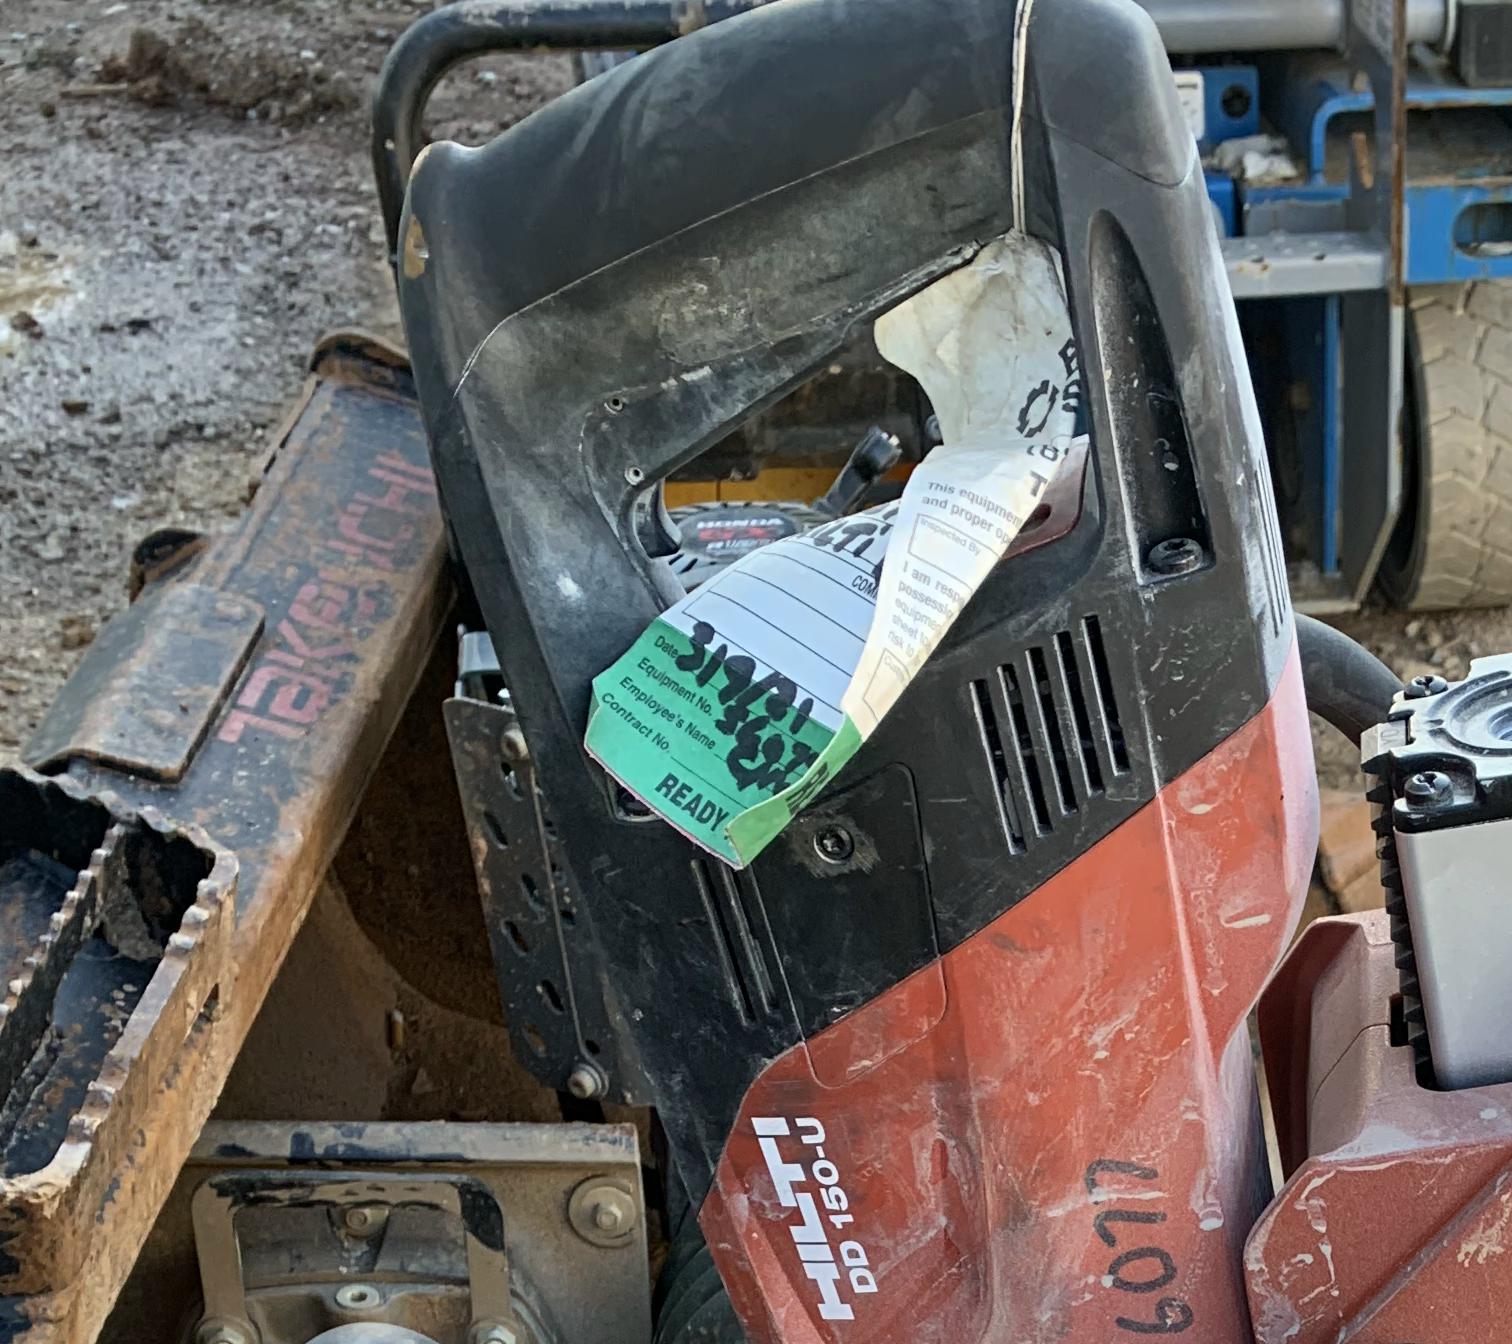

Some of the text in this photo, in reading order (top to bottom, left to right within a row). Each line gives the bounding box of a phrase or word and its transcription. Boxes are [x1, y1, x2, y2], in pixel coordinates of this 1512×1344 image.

[922, 496, 949, 509] and
[950, 503, 993, 532] proper
[928, 482, 956, 494] This
[911, 569, 932, 586] am
[654, 635, 679, 659] Date
[619, 675, 716, 750] Employee's Name
[637, 657, 712, 716] Equipment No.
[601, 692, 670, 753] Contract No.
[655, 772, 729, 832] READY
[751, 1117, 855, 1320] HILTI
[795, 1117, 878, 1293] DD 150-U
